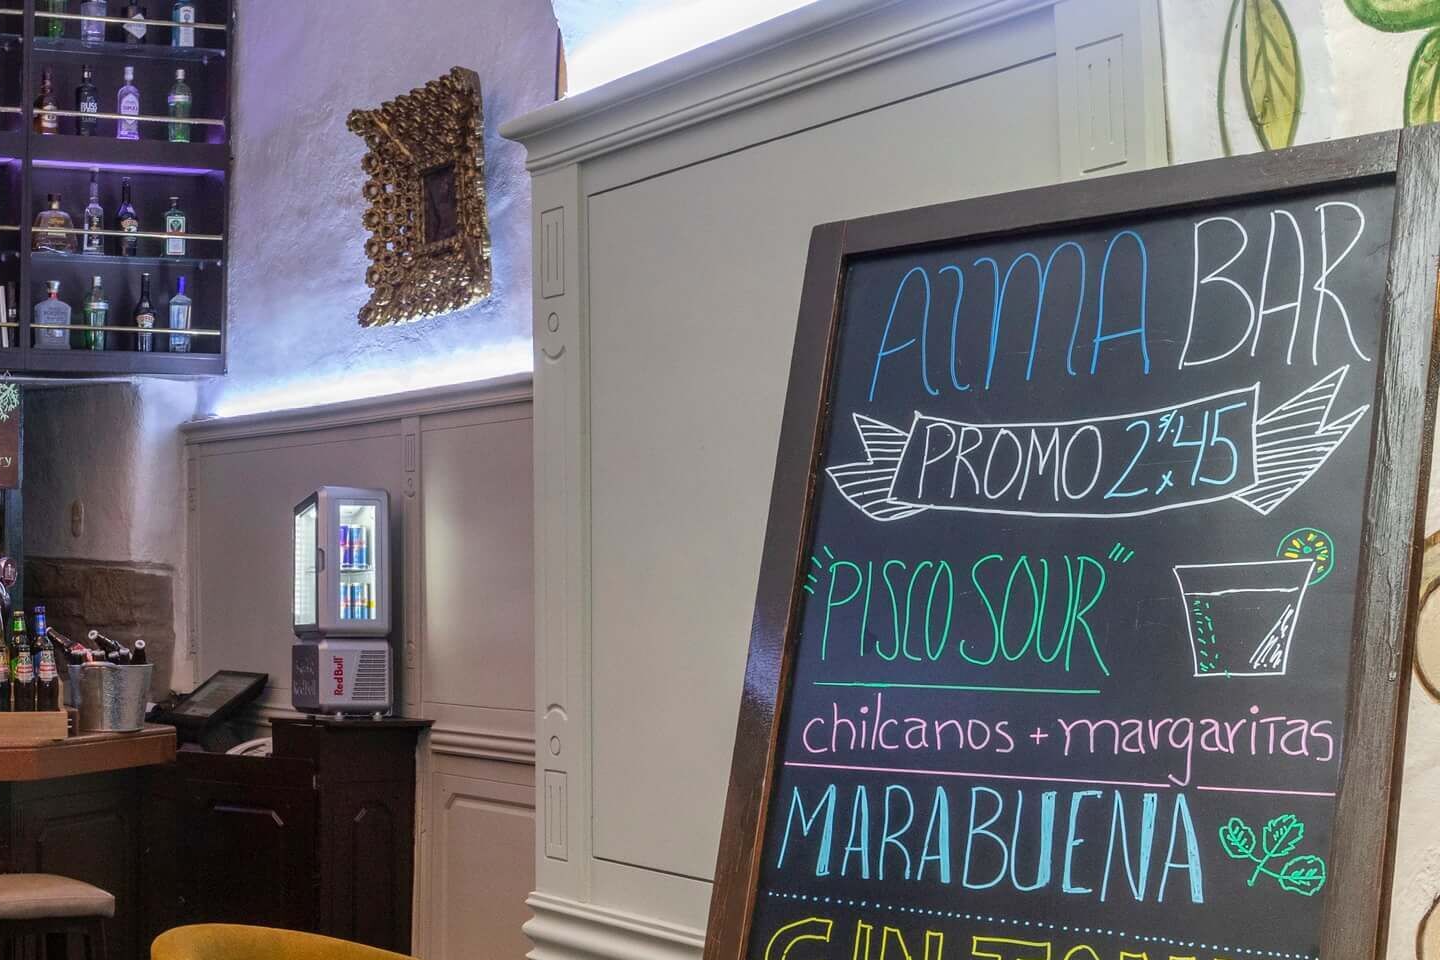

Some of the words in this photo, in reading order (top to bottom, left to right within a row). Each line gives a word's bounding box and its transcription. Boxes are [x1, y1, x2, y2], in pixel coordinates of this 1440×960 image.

[1178, 200, 1372, 370] BAR
[917, 422, 1105, 504] PROMO
[820, 559, 954, 663] PISCO
[959, 551, 1112, 677] SOUR
[801, 692, 1016, 756] chilcanos
[1030, 725, 1050, 748] +
[1061, 704, 1335, 789] margaritas
[777, 783, 1205, 905] MARABUENA
